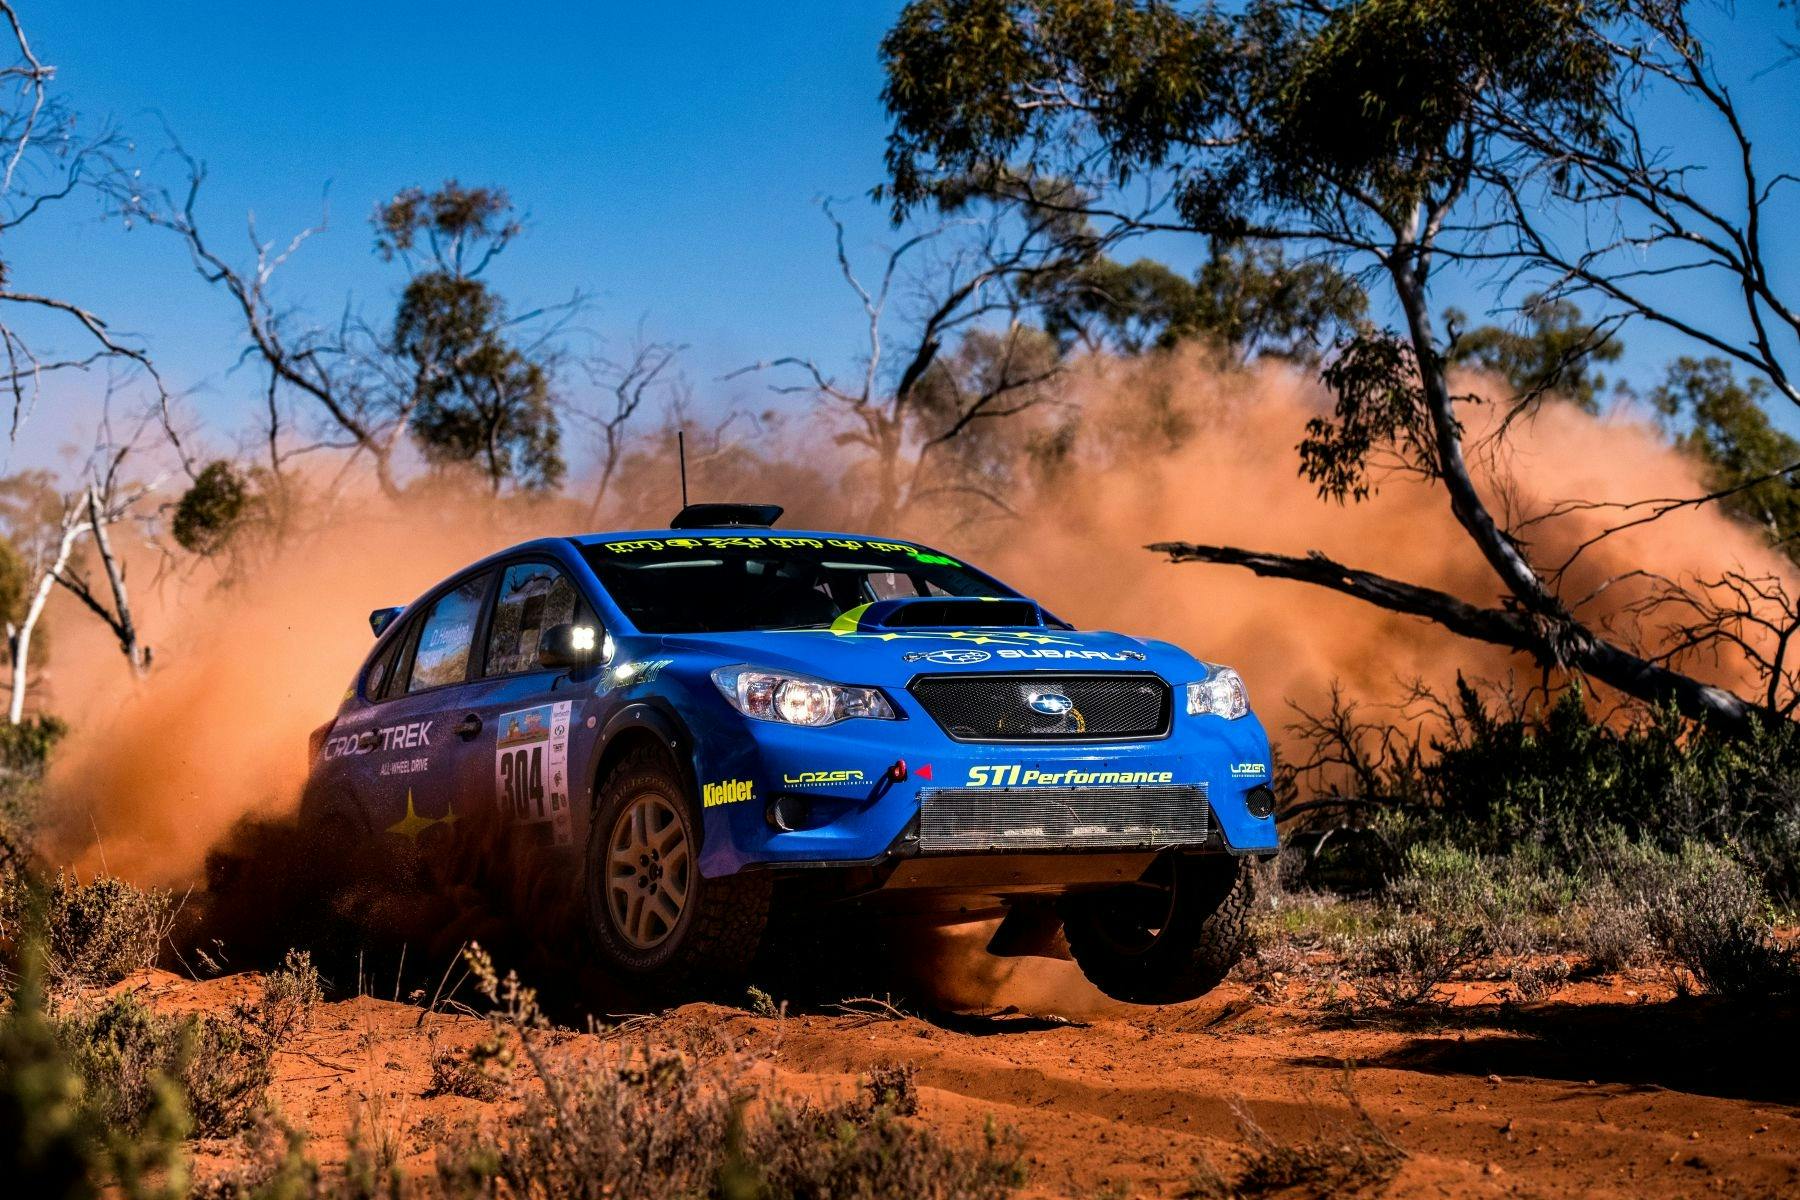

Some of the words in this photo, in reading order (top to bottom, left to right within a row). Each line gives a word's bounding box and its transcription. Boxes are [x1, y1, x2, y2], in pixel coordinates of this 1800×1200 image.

[996, 649, 1128, 661] SUBARU
[323, 720, 434, 761] CROSTREK
[411, 757, 430, 773] DRIVE
[966, 765, 1022, 787] STI
[1021, 769, 1173, 786] Performance
[500, 746, 545, 820] 304
[784, 770, 864, 784] LAZER
[703, 779, 753, 808] Kielder
